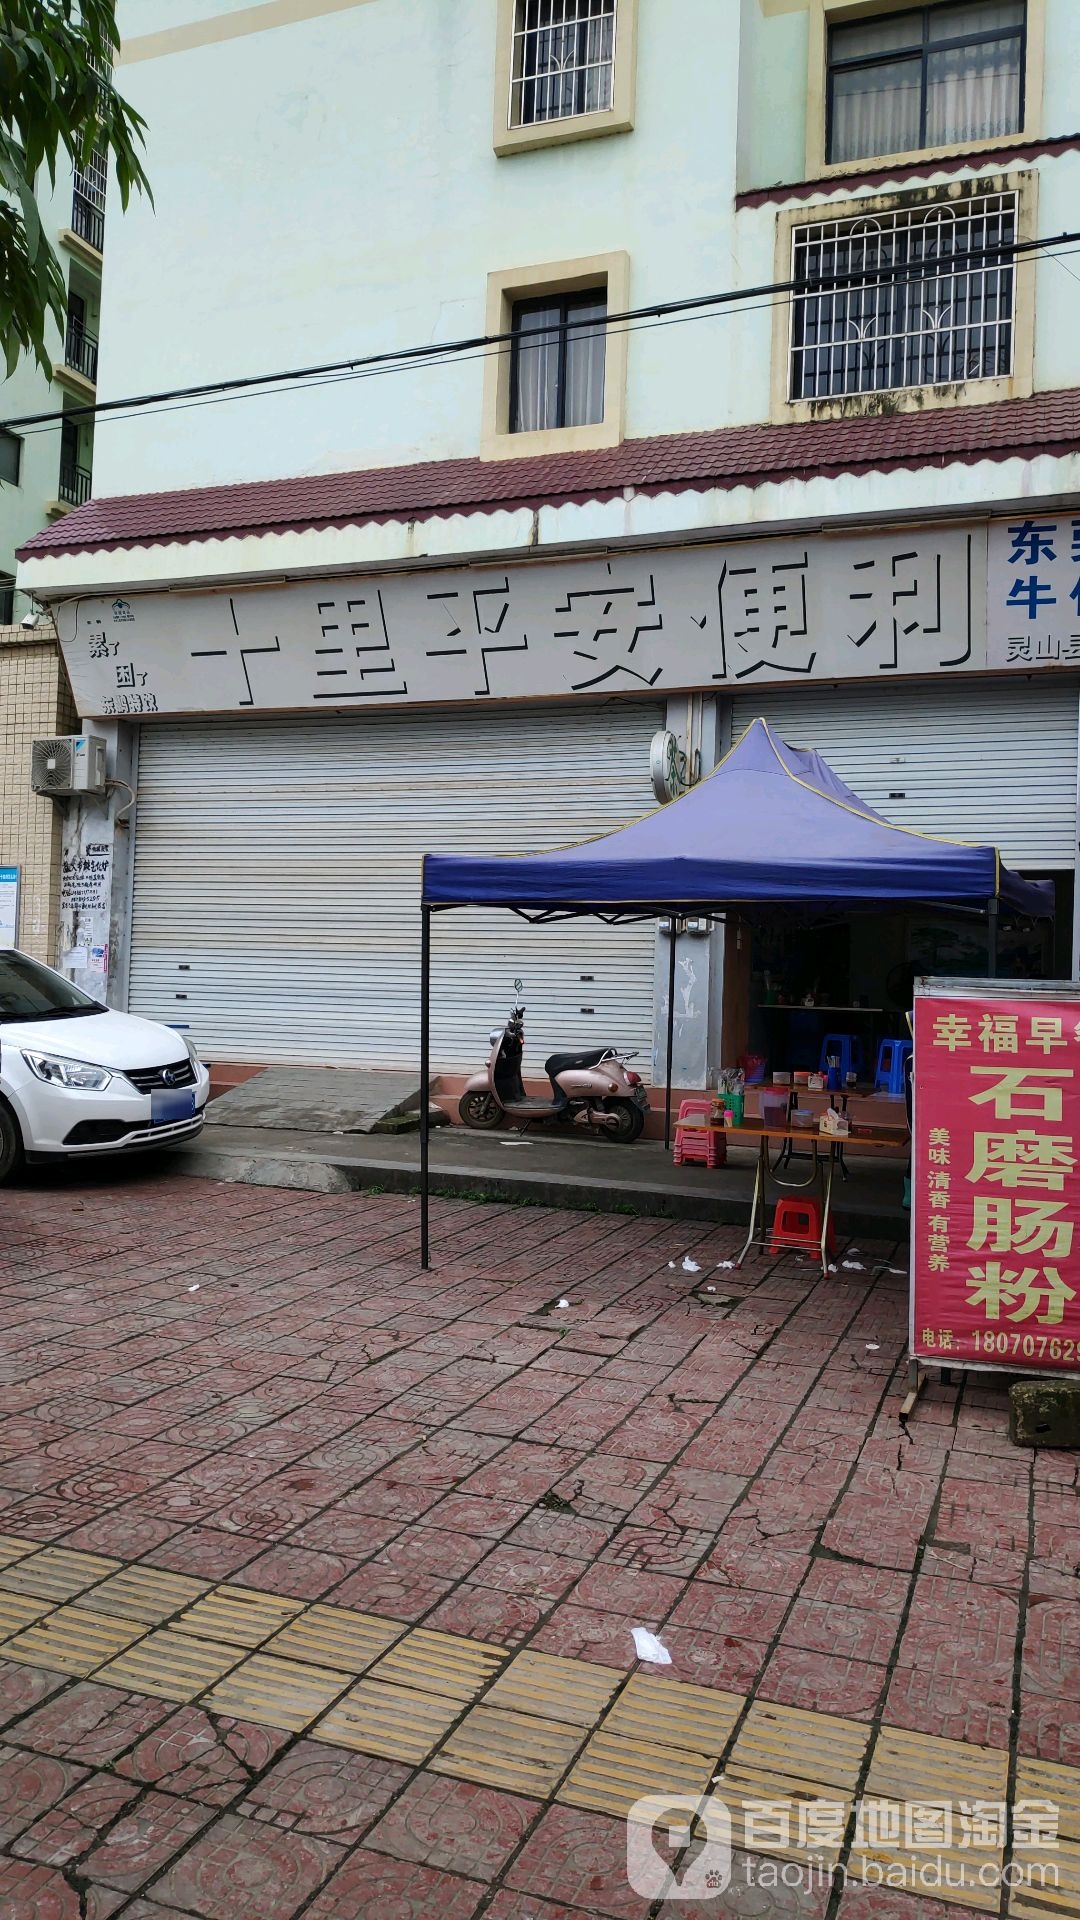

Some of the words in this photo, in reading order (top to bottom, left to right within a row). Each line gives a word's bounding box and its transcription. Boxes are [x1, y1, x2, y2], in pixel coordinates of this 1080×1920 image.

[1007, 520, 1080, 565] 东
[1006, 575, 1080, 620] 牛
[187, 533, 972, 706] 十里平安便利
[88, 631, 120, 659] 累了
[116, 662, 148, 689] 困了
[932, 1013, 1080, 1055] 幸福早
[964, 1066, 1077, 1324] 石磨肠粉
[972, 1330, 1080, 1361] 18070762
